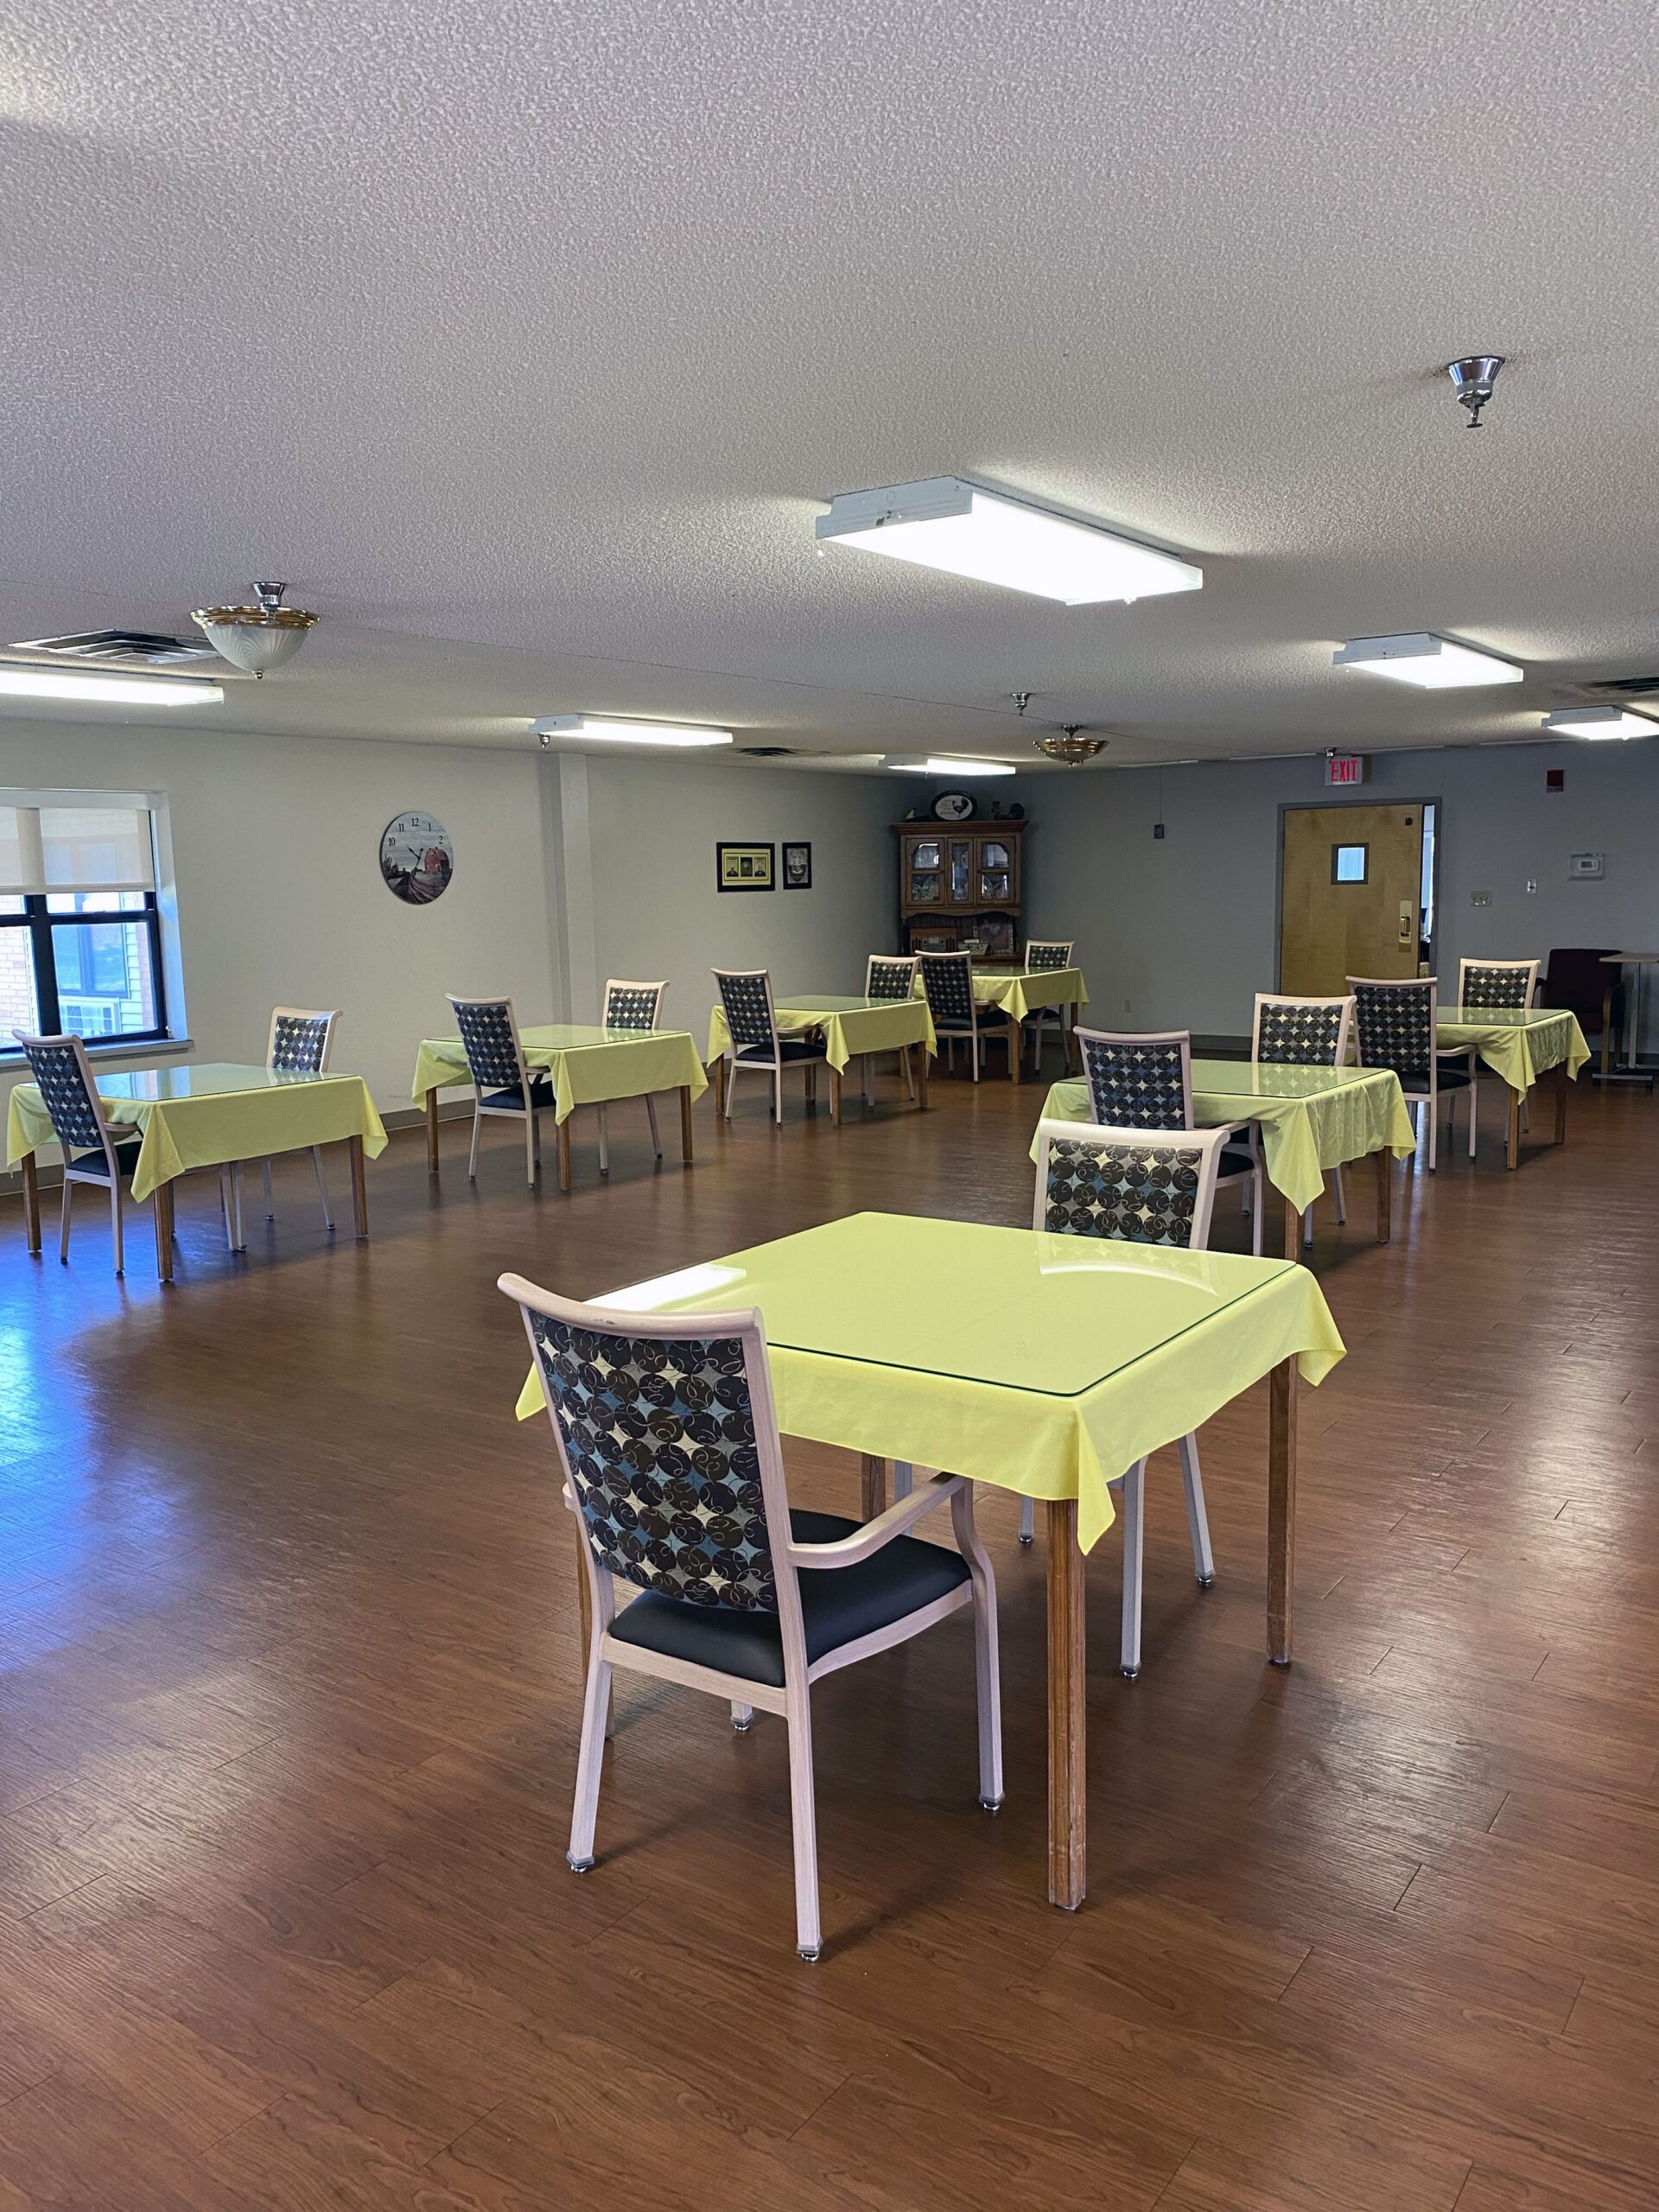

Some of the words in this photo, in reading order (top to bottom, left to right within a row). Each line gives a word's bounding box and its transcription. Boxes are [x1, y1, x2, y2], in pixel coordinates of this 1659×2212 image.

[1331, 760, 1357, 781] EXIT
[411, 817, 419, 827] 12
[398, 823, 404, 832] 11
[388, 837, 396, 846] 10
[439, 836, 443, 844] 2
